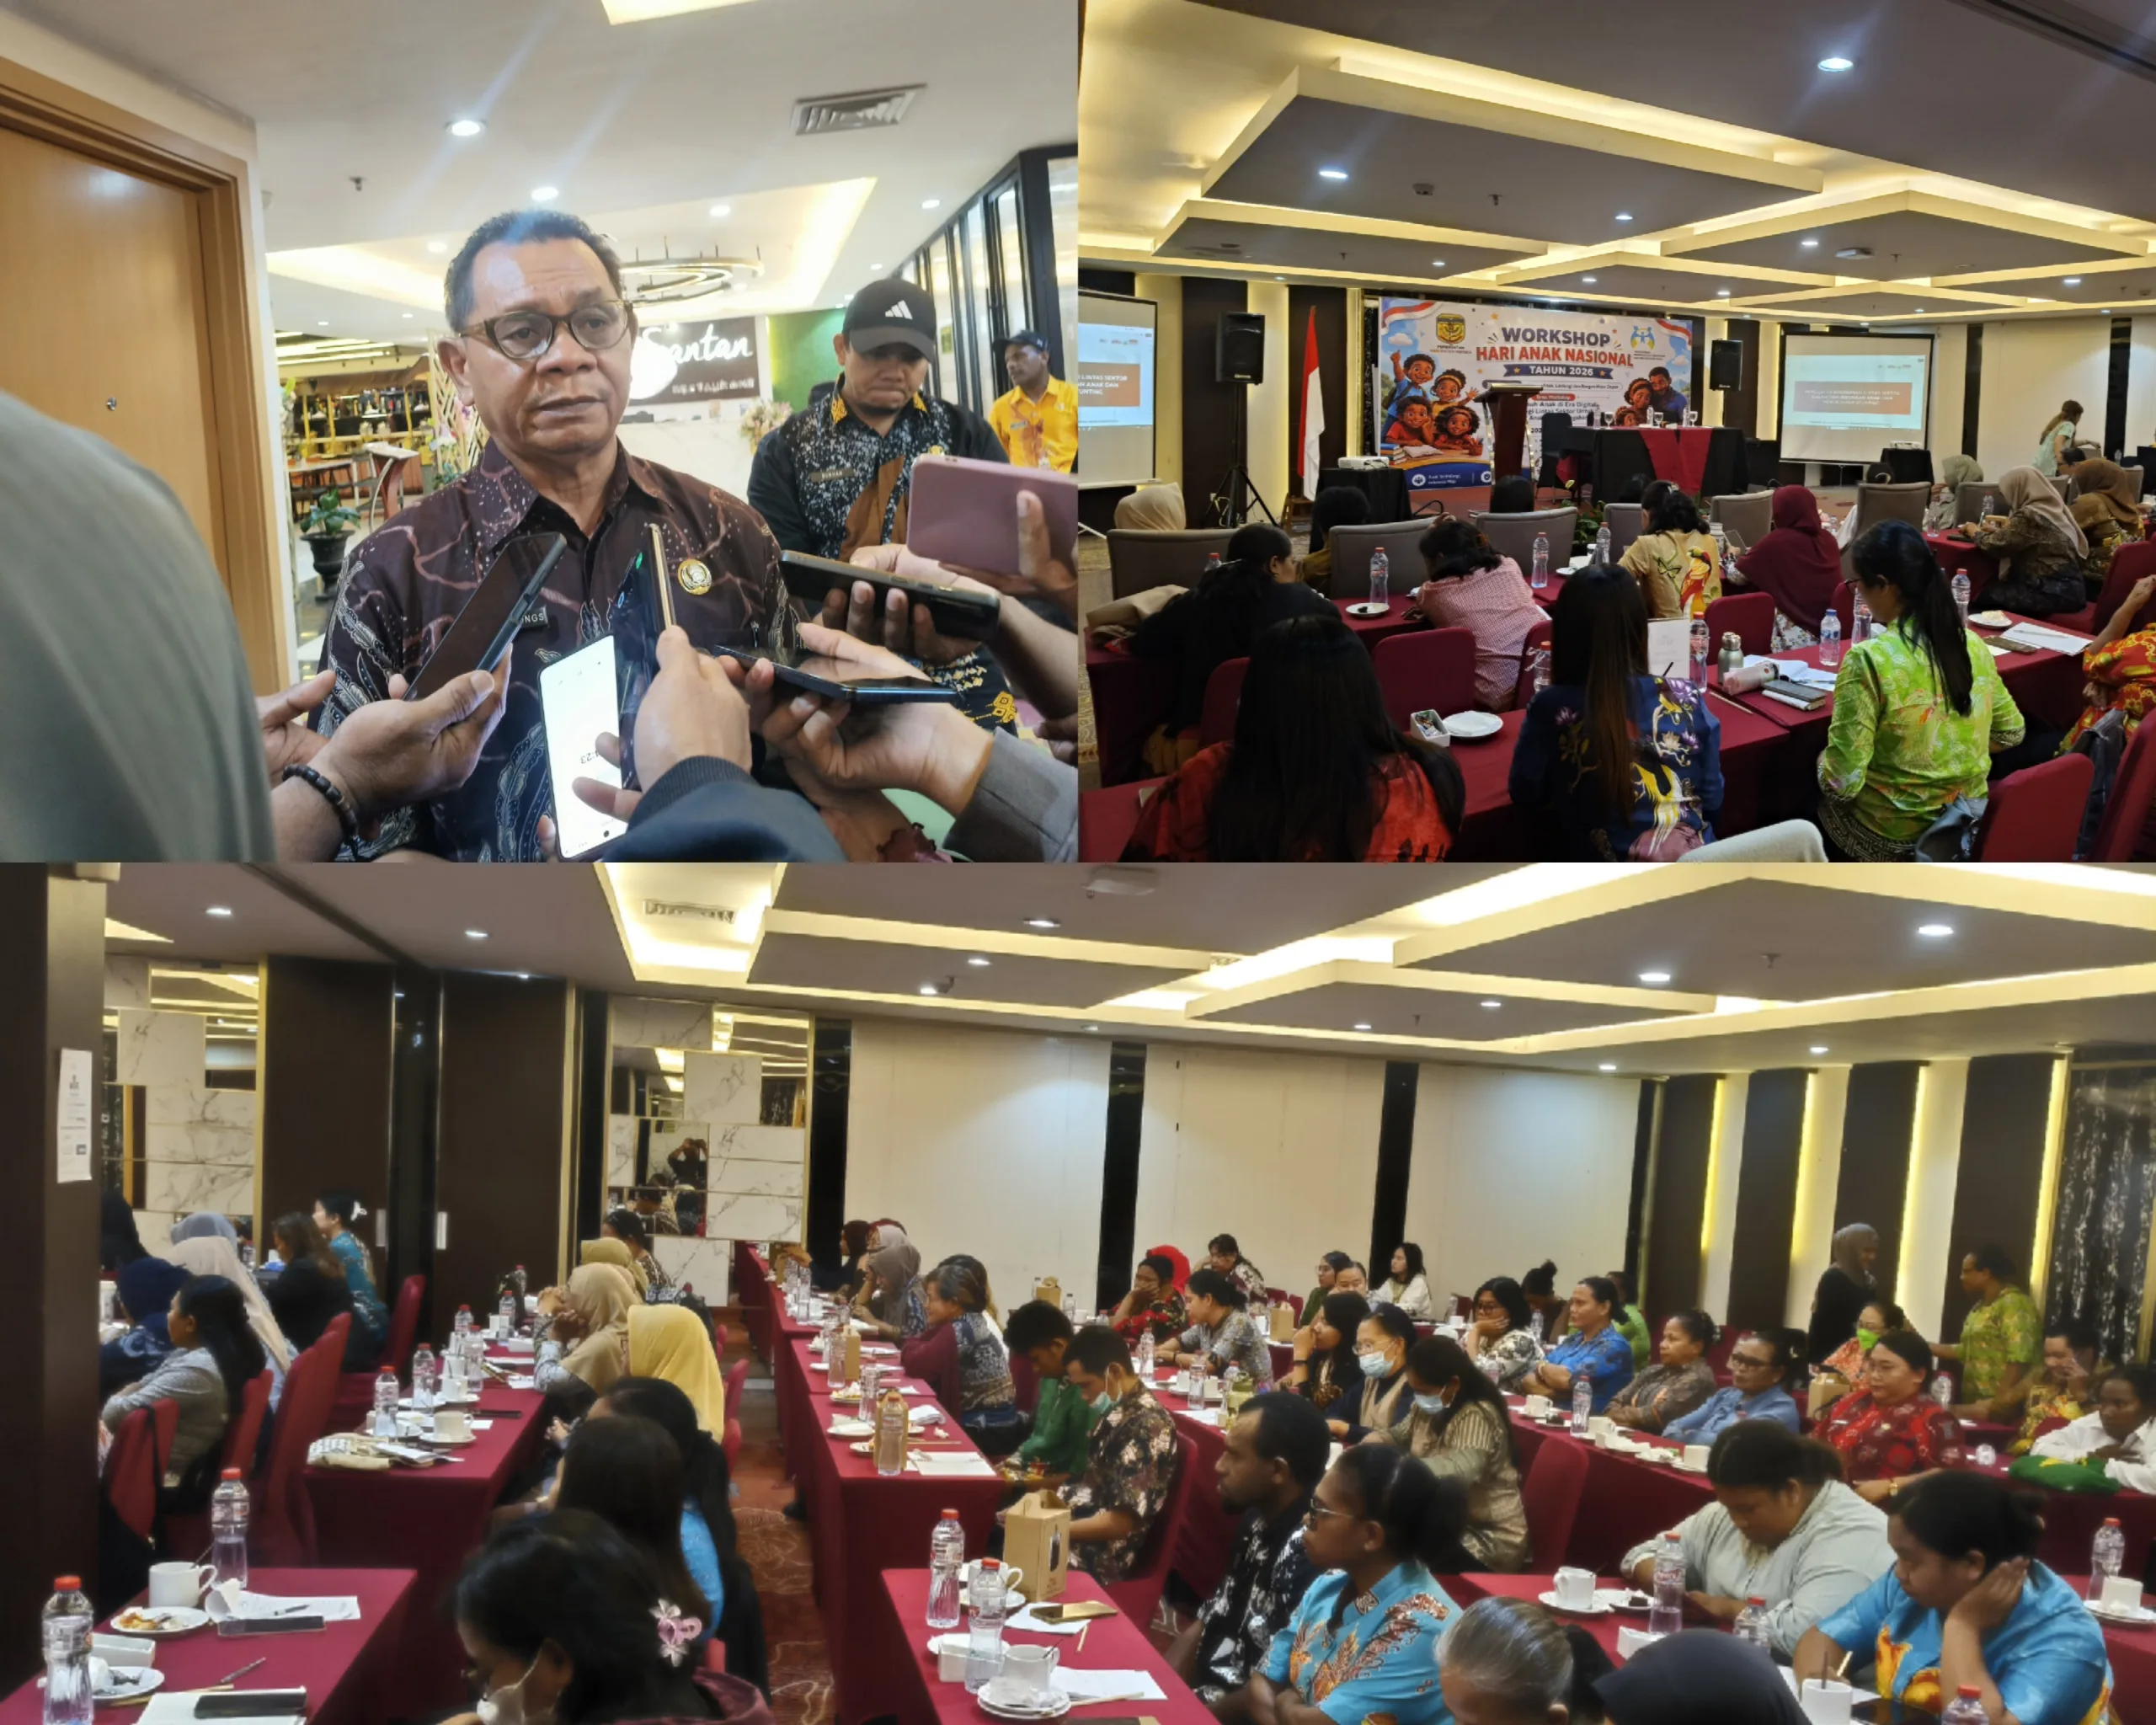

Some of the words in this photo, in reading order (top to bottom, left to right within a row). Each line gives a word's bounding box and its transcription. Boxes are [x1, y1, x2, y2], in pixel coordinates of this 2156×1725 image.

[1502, 327, 1610, 347] WORKSHOP
[1476, 346, 1514, 361] HARI
[1518, 347, 1561, 361] ANAK
[1565, 348, 1634, 367] NASIONAL
[1529, 366, 1566, 375] TAHUN
[1569, 366, 1593, 376] 2026
